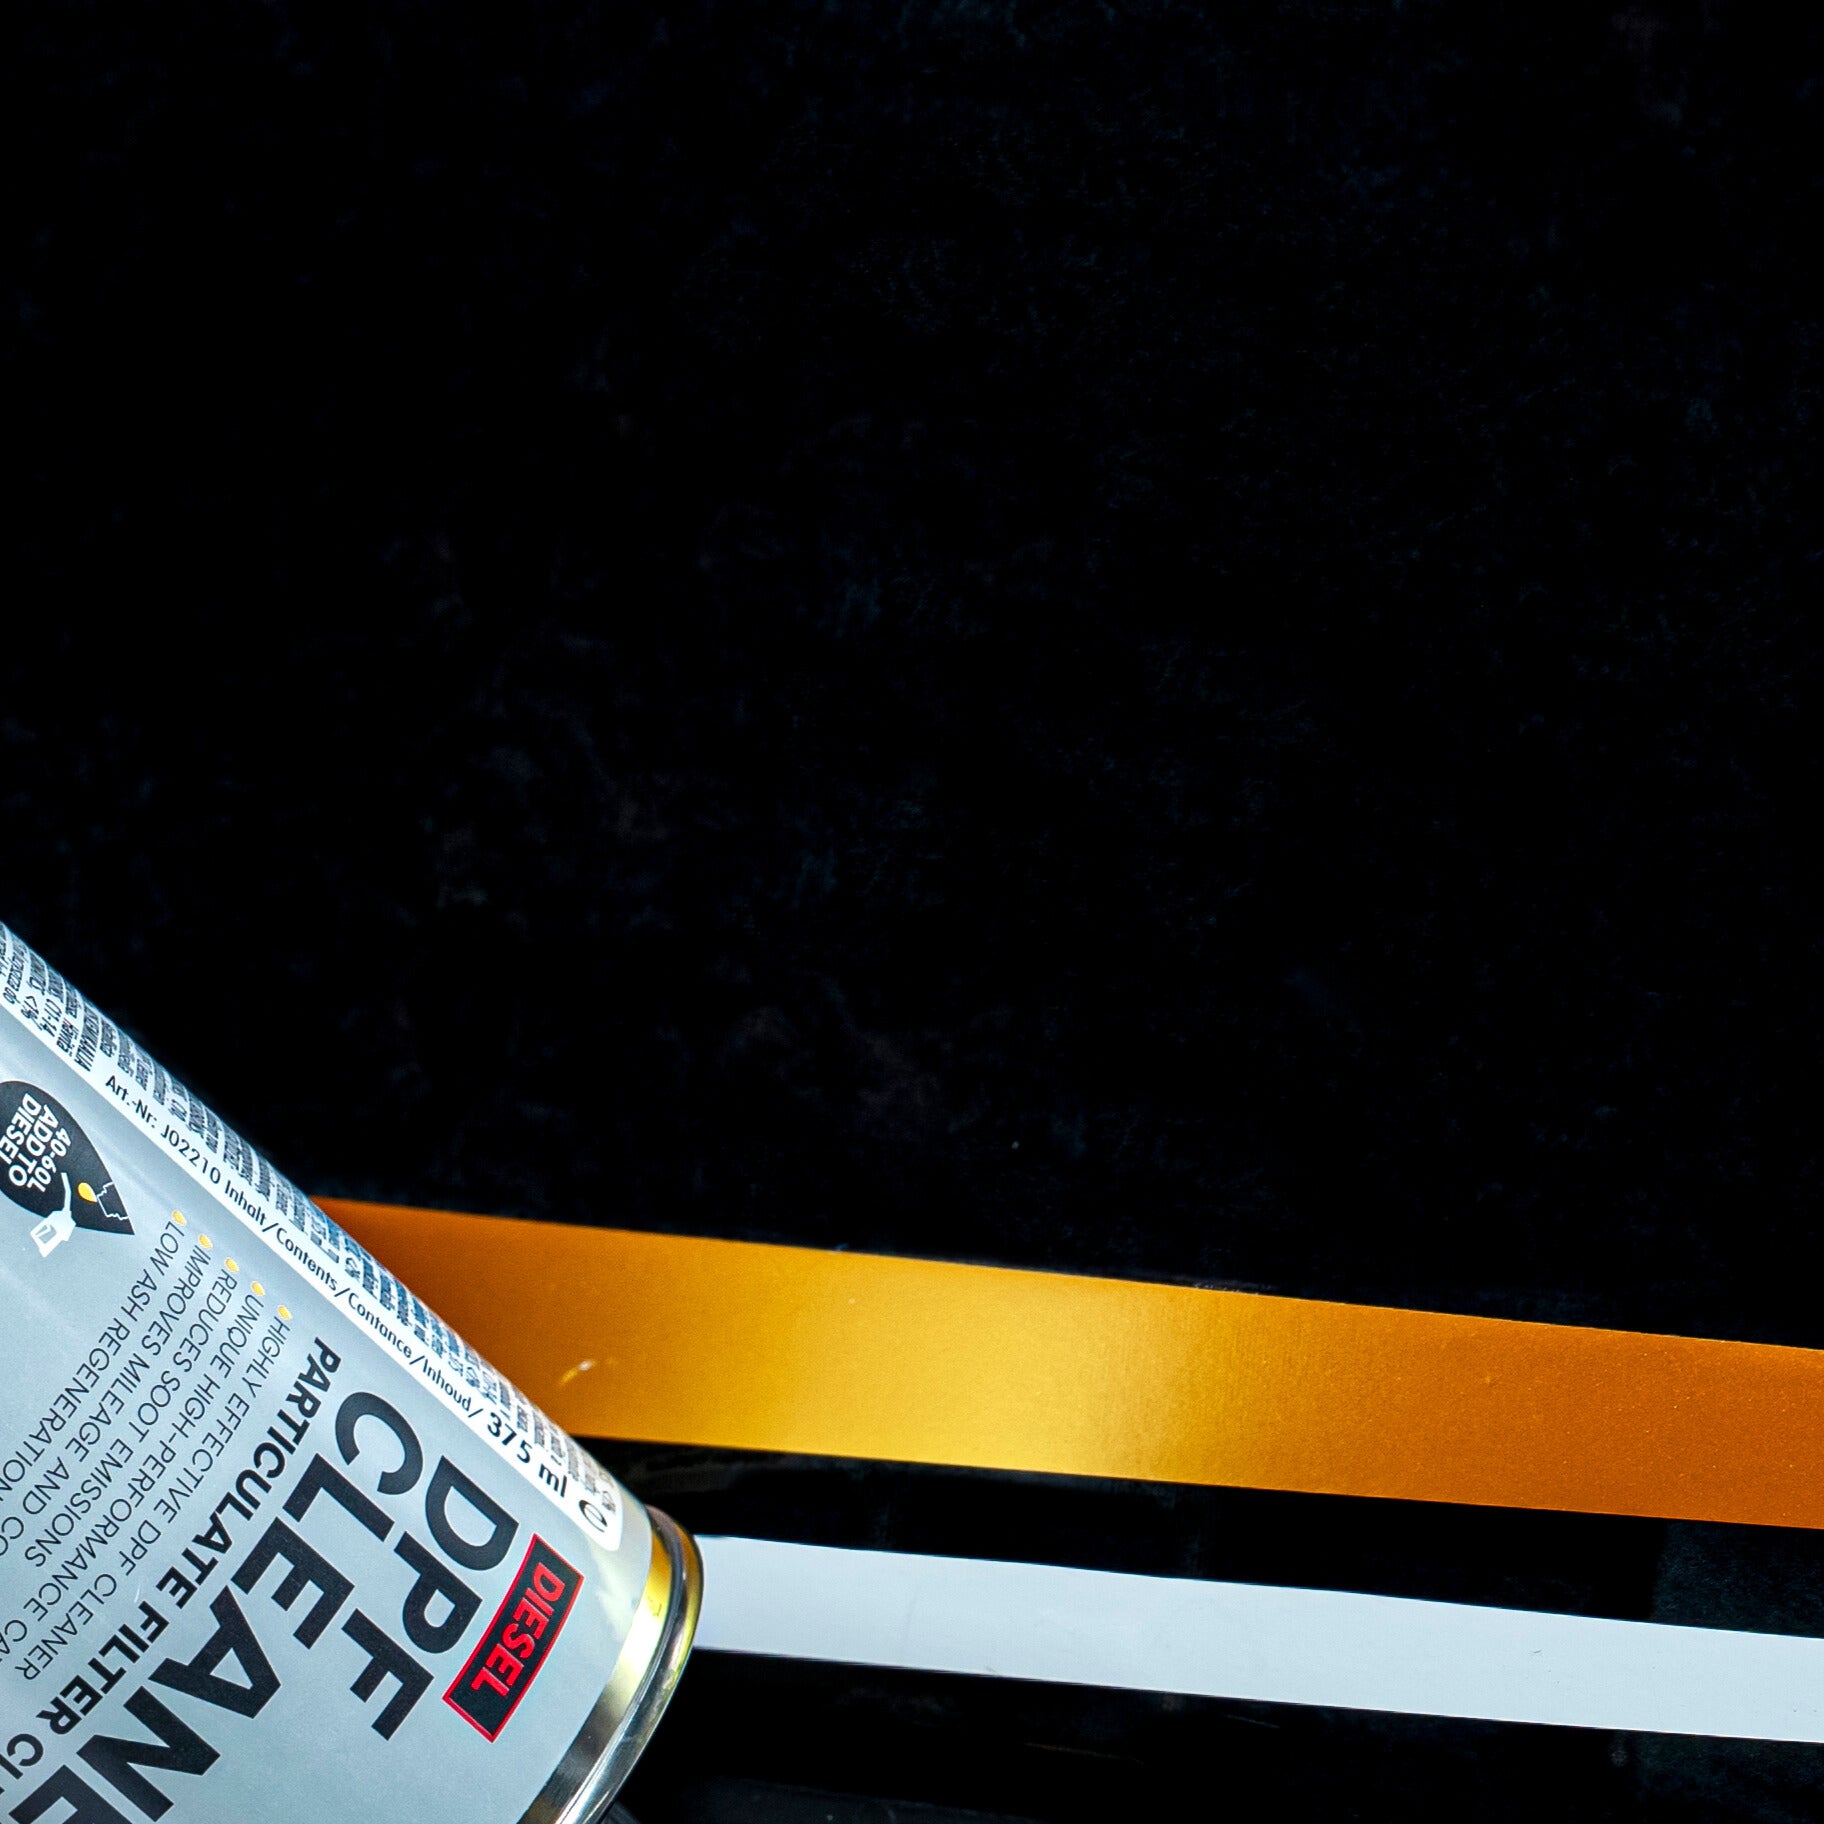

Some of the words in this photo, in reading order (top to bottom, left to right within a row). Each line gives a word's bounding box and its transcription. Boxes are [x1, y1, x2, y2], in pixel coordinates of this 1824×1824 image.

[8, 1151, 37, 1185] TO
[24, 1104, 59, 1156] ADD
[25, 1127, 72, 1193] 40-60L
[119, 1268, 157, 1322] ASH
[149, 1220, 184, 1276] LOW
[139, 1244, 211, 1356] IMPROVES
[170, 1268, 237, 1372] REDUCES
[208, 1294, 263, 1379] UNIQUE
[241, 1315, 291, 1398] HIGHLY
[64, 1352, 150, 1462] MILEAGE
[128, 1369, 180, 1443] SOOT
[22, 1372, 220, 1622] HIGH-PERFORMANCE
[22, 1437, 134, 1568] EMISSIONS
[25, 1455, 71, 1514] AND
[152, 1392, 249, 1523] EFFECTIVE
[154, 1336, 340, 1609] PARTICULATE
[483, 1412, 538, 1464] 375
[535, 1463, 565, 1498] ml
[118, 1519, 162, 1576] DPF
[13, 1575, 115, 1681] CLEANER
[340, 1455, 520, 1741] DPF
[468, 1561, 567, 1698] DIESEL
[35, 1600, 169, 1736] FILTER
